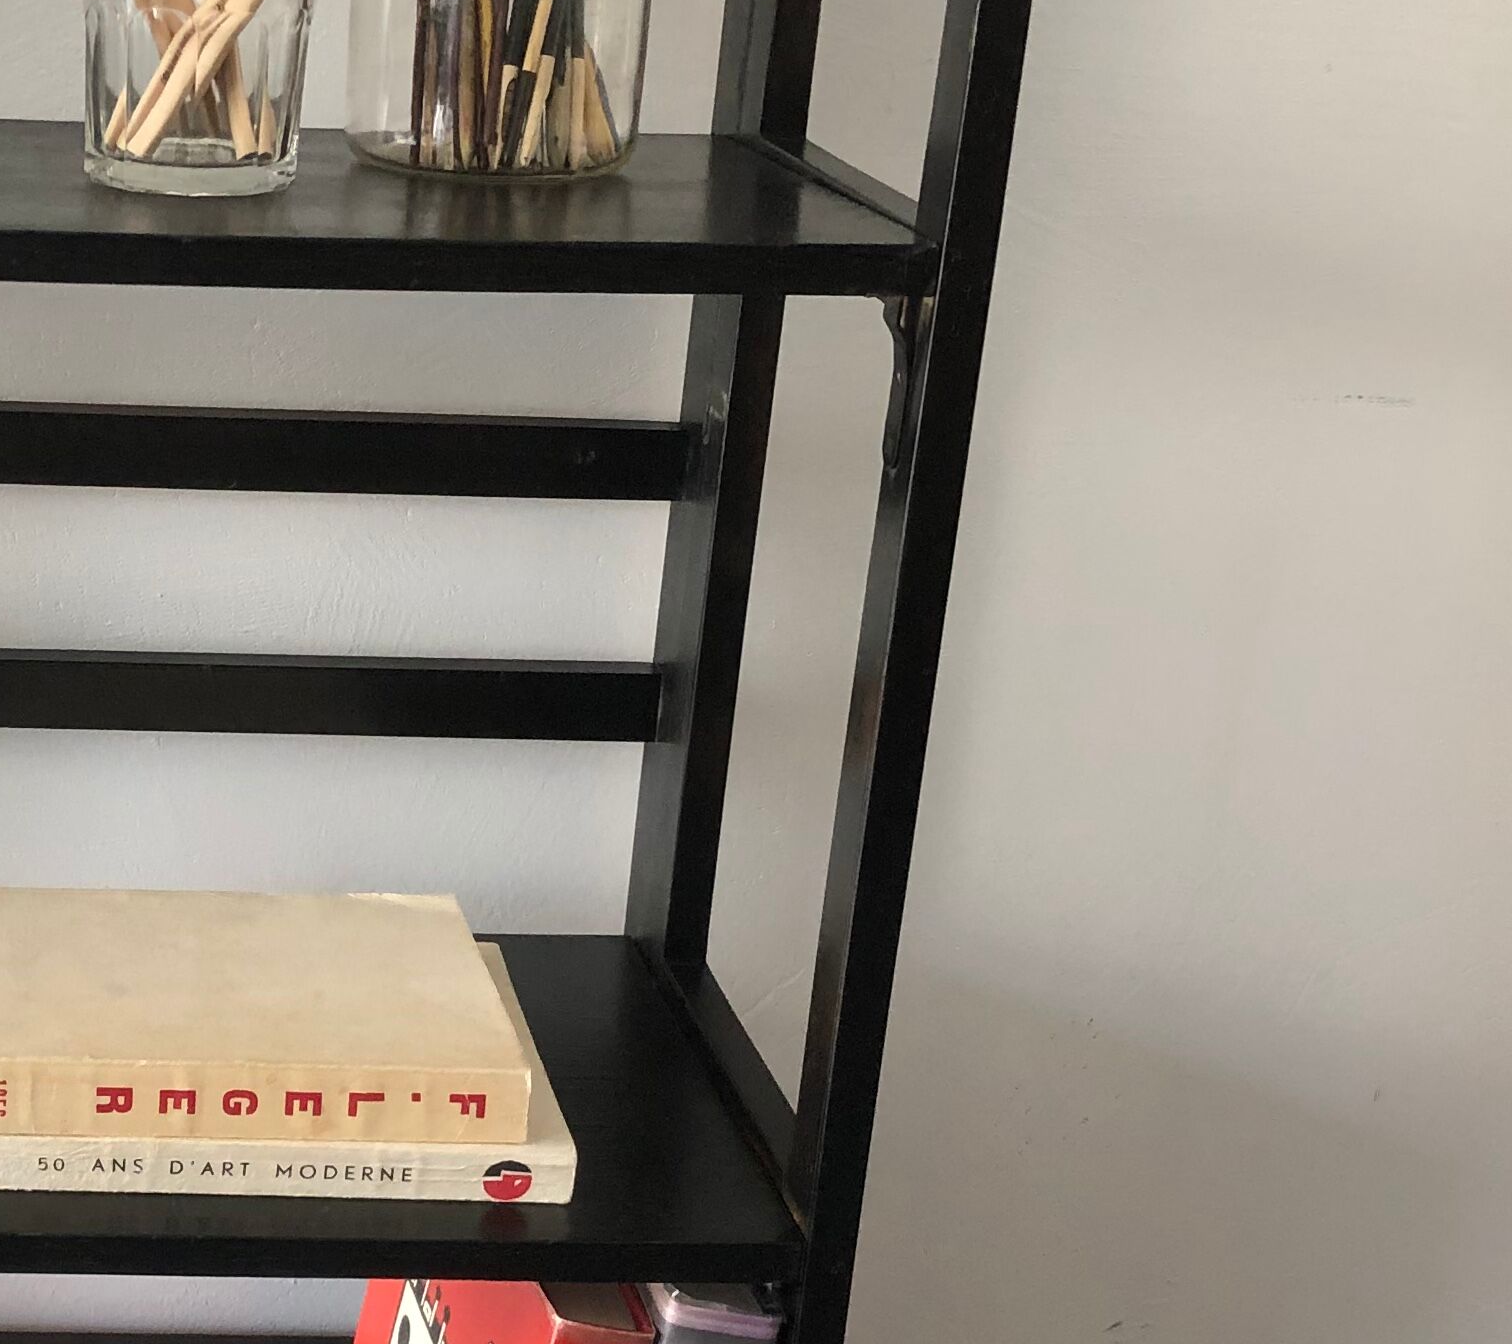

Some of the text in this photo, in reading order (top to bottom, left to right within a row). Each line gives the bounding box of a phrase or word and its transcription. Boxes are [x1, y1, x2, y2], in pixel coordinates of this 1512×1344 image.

[38, 1158, 414, 1183] 50 ANS D'ART MODERNE
